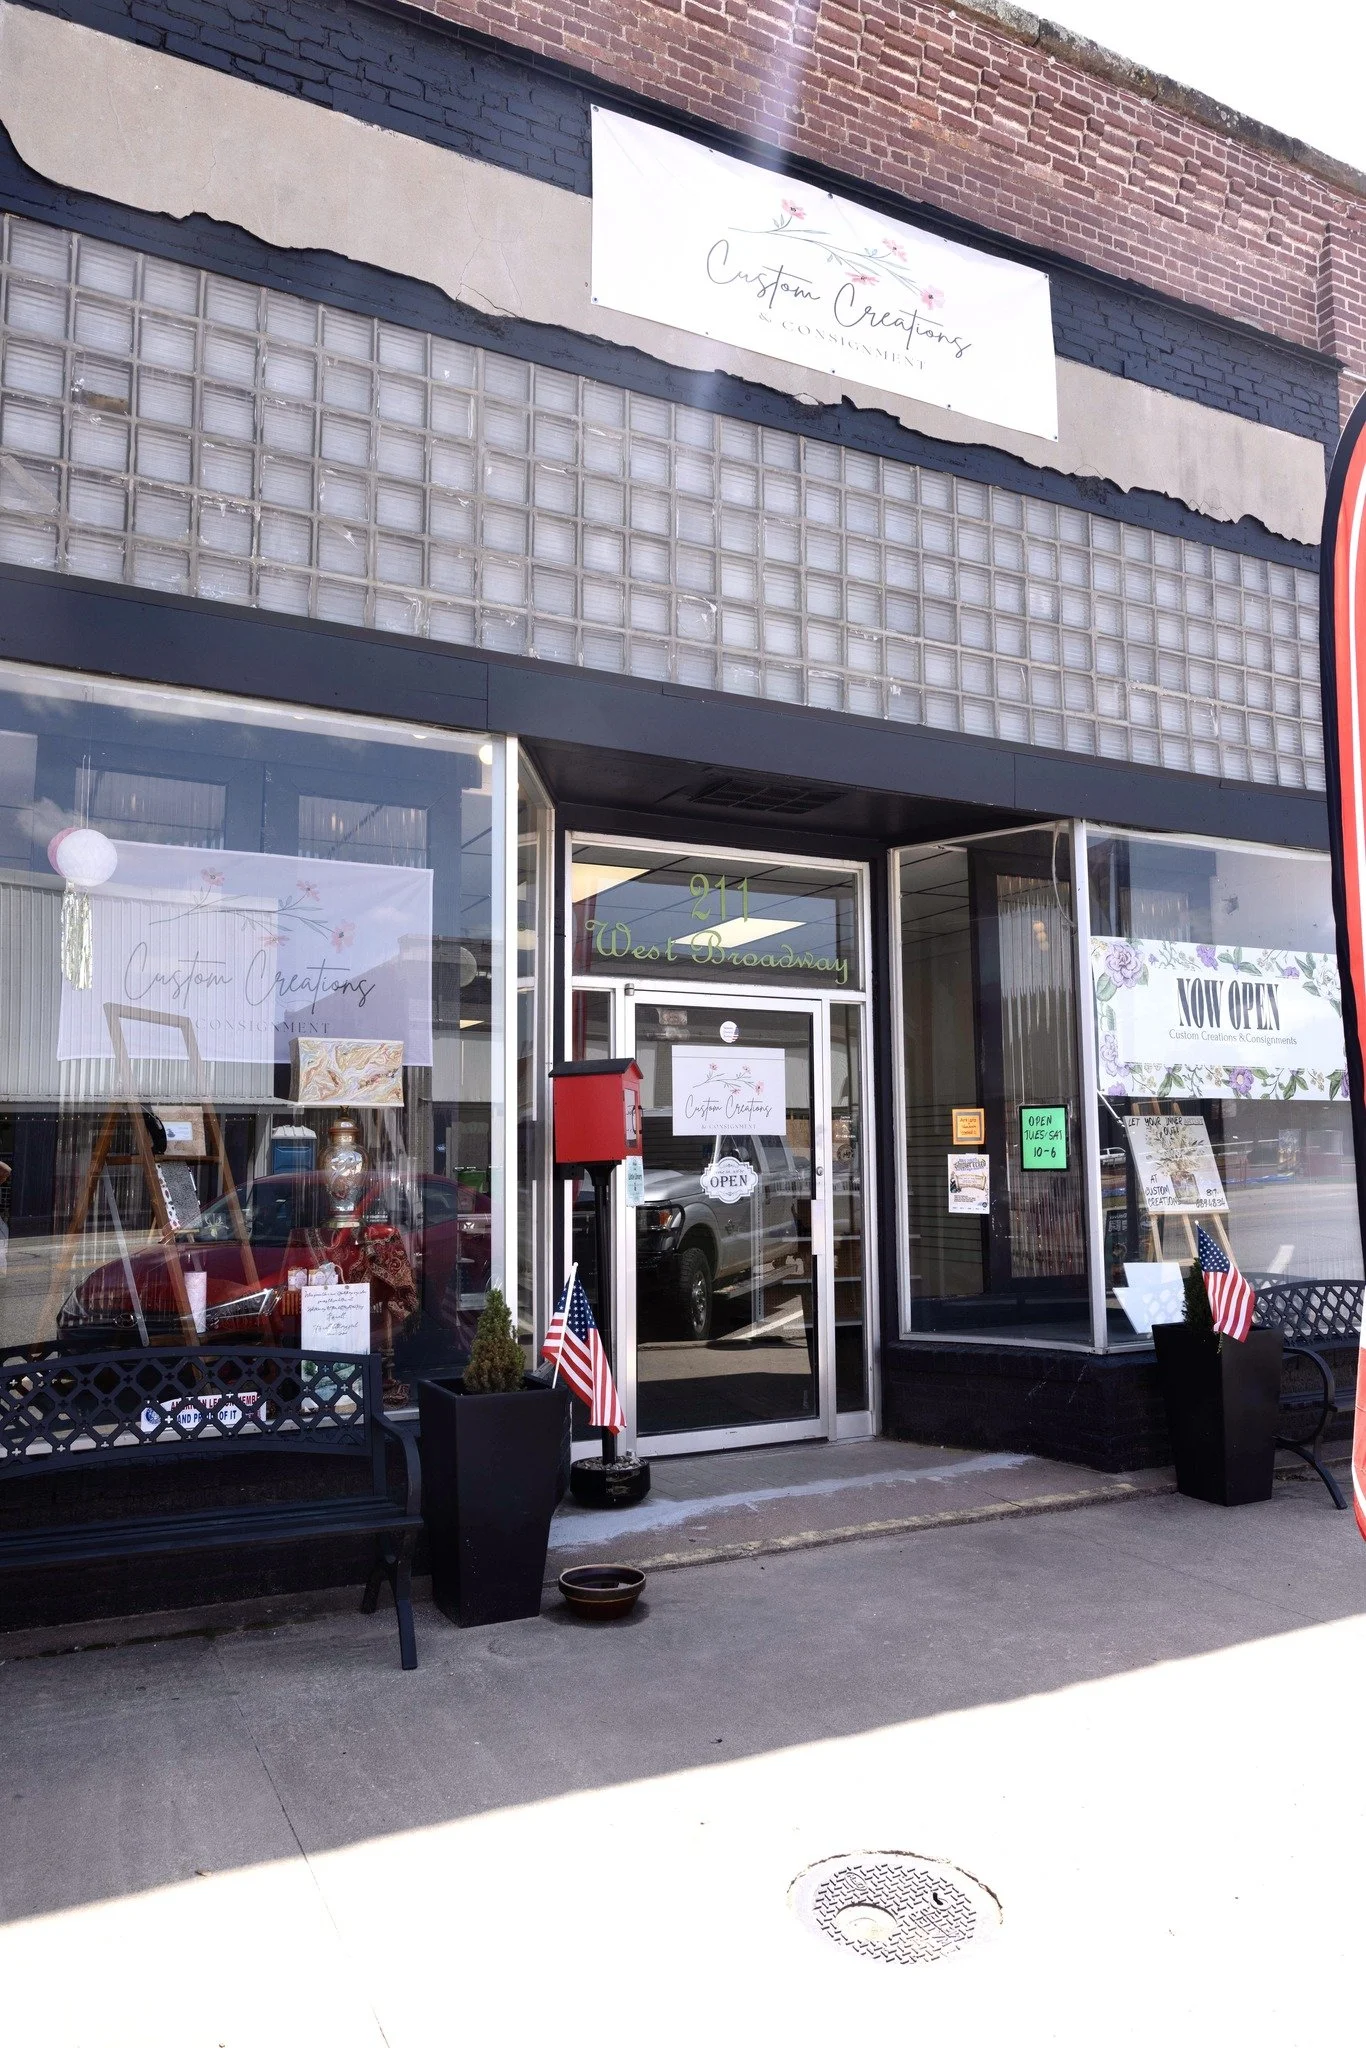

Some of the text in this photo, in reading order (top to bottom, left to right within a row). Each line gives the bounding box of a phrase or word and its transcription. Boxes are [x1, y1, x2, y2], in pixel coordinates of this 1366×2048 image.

[706, 239, 972, 359] Custom Creations
[758, 312, 927, 371] & CONSIGNMENT
[690, 873, 749, 922] 211
[585, 919, 849, 985] West Broadway
[124, 941, 376, 1015] Custom Creations
[1176, 977, 1280, 1031] NOW OPEN
[194, 1017, 331, 1034] CONSIGNMENT
[1169, 1028, 1200, 1040] Custom
[1201, 1030, 1238, 1043] Creations
[685, 1094, 773, 1121] Custom Creations
[1028, 1115, 1053, 1127] OPEN
[1128, 1117, 1140, 1127] LET
[1144, 1116, 1161, 1126] YOUR
[710, 1174, 748, 1188] OPEN
[1150, 1173, 1158, 1184] AT
[1146, 1185, 1170, 1196] CUSTOM
[219, 1410, 228, 1421] OF
[230, 1409, 237, 1420] IT
